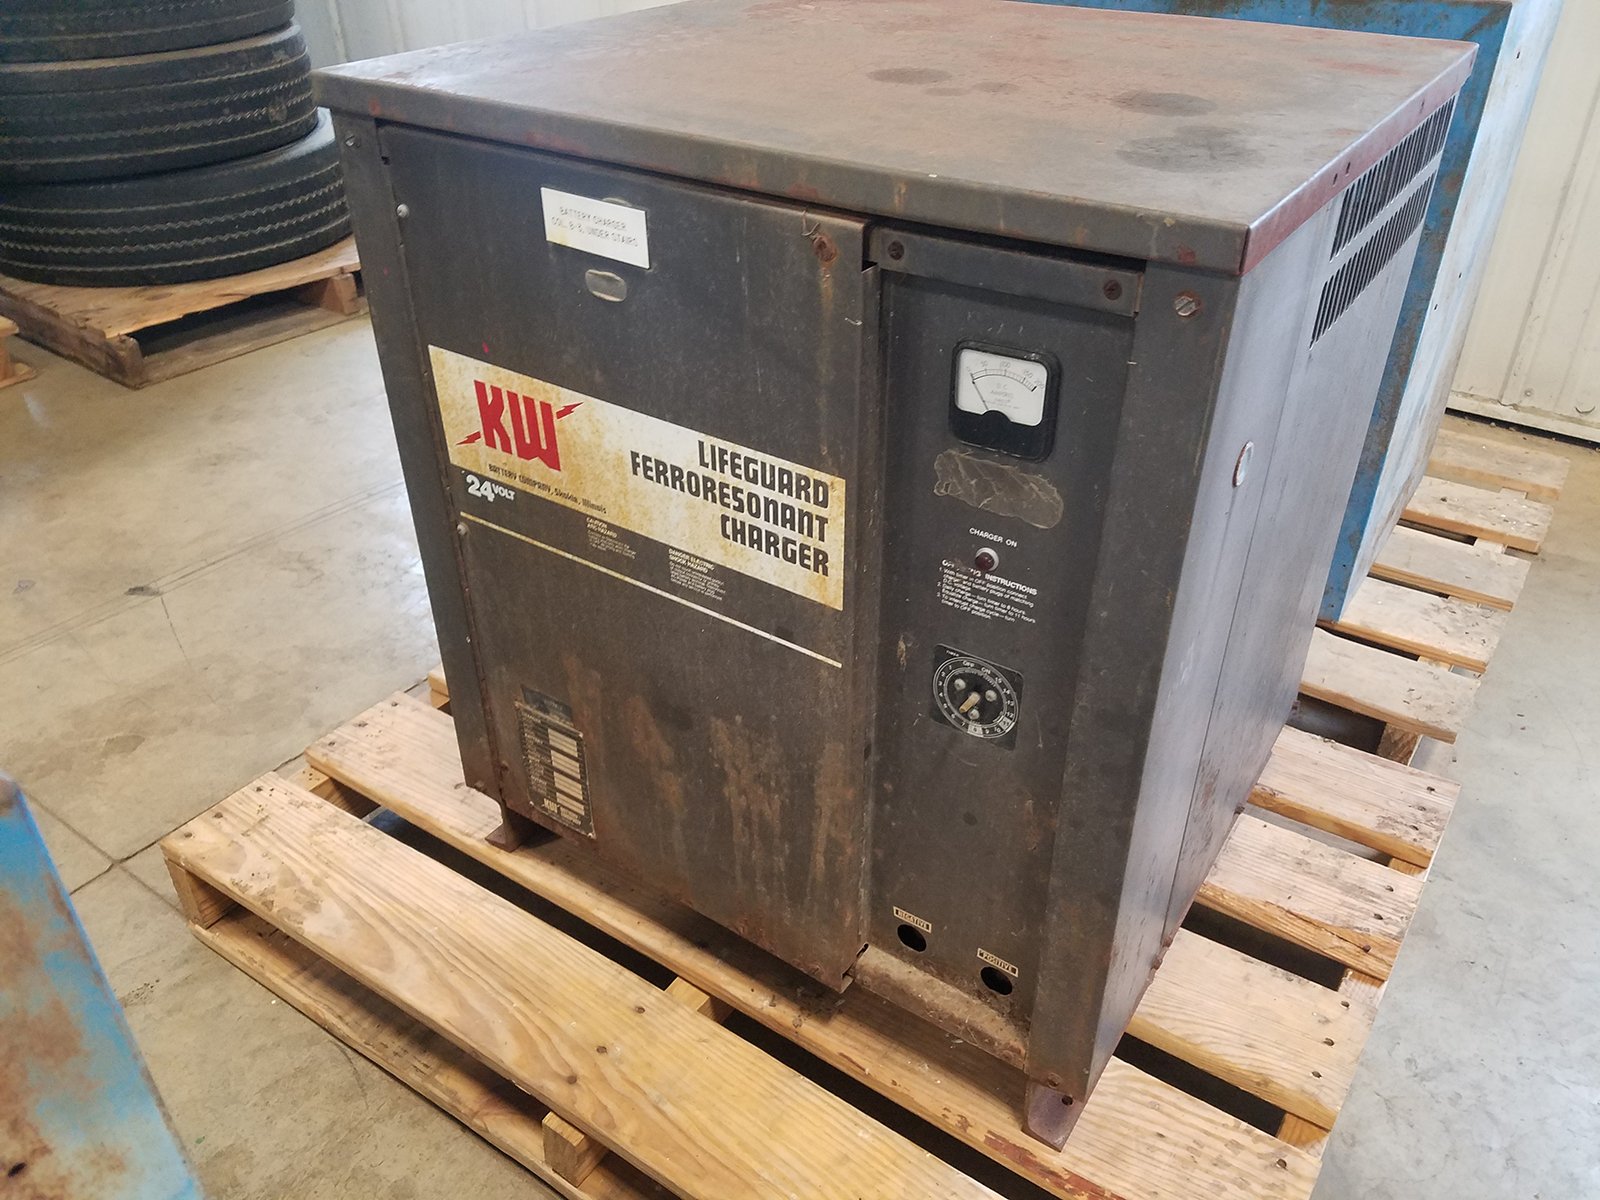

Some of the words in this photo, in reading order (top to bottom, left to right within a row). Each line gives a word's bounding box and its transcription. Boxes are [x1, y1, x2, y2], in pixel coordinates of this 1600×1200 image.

[560, 206, 591, 221] BATTERY
[593, 215, 627, 231] CHARGER
[611, 231, 639, 247] STAIRS
[474, 379, 561, 471] KW
[488, 463, 517, 480] BATTERY
[698, 440, 829, 509] LIFEGUARD
[466, 474, 494, 502] 24
[492, 483, 516, 501] VOLT
[630, 450, 829, 542] FERRORESONANT
[720, 514, 829, 577] CHARGER
[969, 527, 1003, 543] CHARGER
[1005, 538, 1018, 548] ON
[984, 573, 1038, 596] INSTRUCTIONS
[1010, 596, 1034, 609] matching
[962, 660, 975, 668] OFF
[981, 666, 991, 675] ON
[898, 908, 927, 930] NEGATIVE
[981, 950, 1012, 972] POSITIVE
